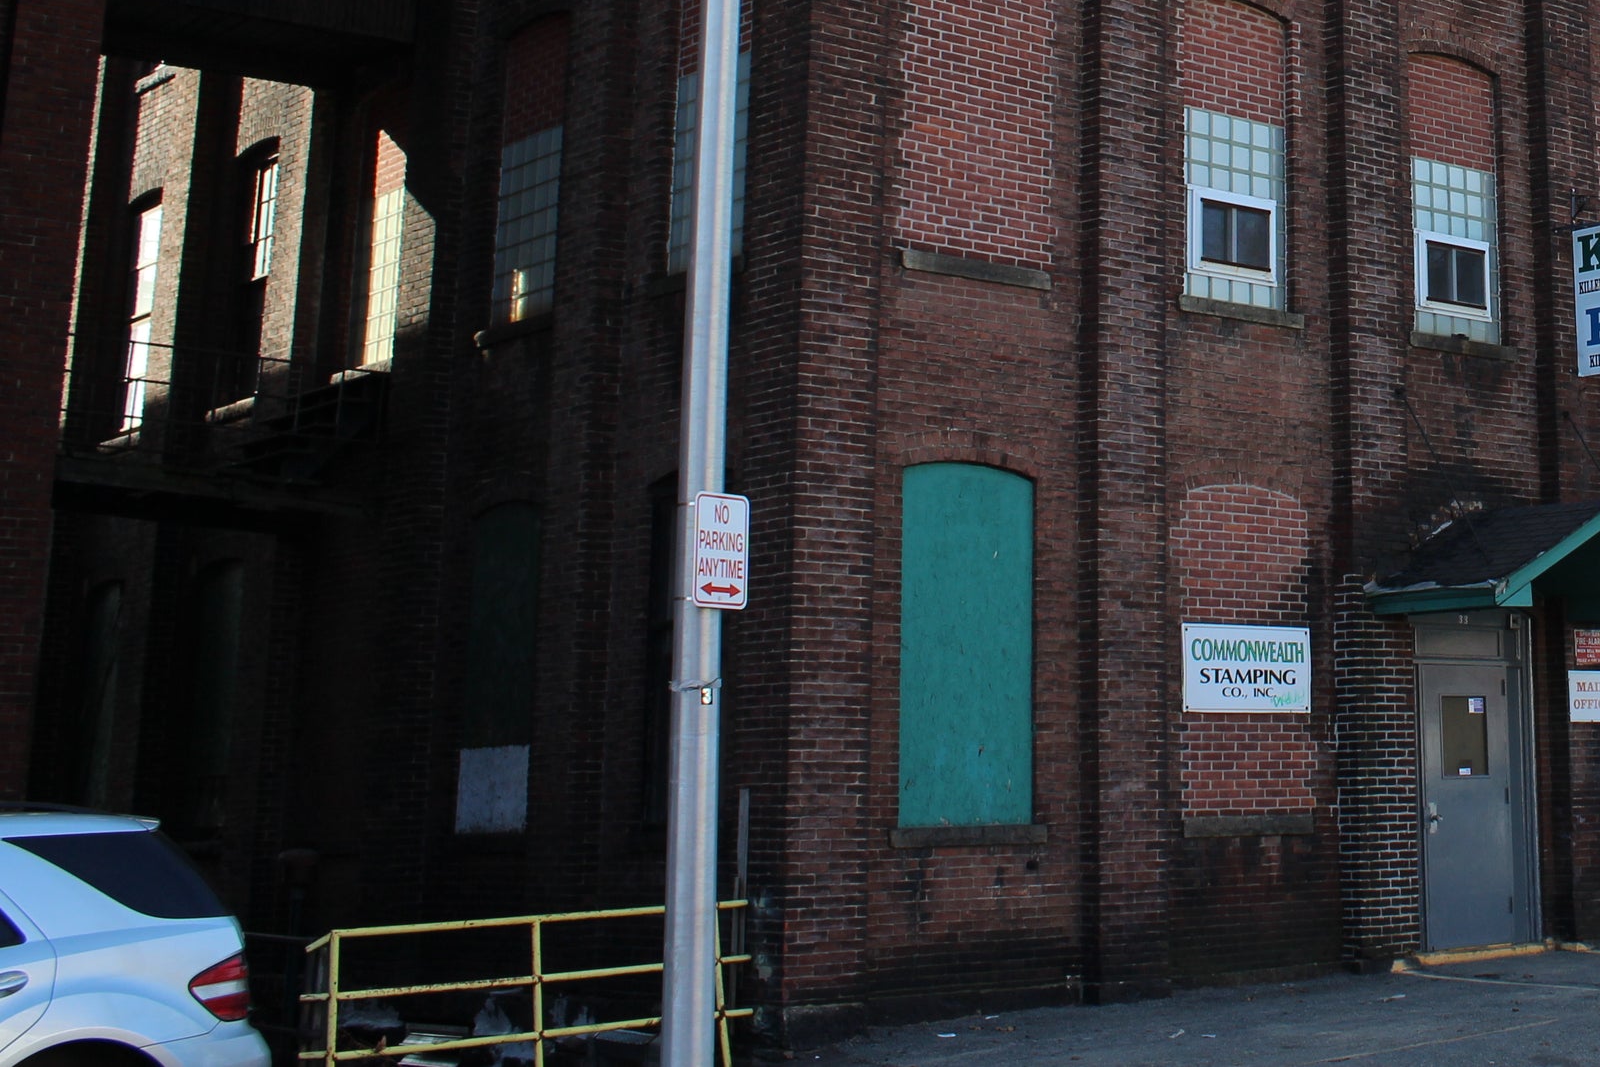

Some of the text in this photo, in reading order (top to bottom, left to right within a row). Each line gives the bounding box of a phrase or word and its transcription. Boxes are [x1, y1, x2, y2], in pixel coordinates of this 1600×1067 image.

[714, 504, 730, 524] NO
[699, 530, 743, 553] PARKING
[698, 557, 743, 579] ANYTIME
[1191, 638, 1305, 663] COMMONWEALTH
[1200, 668, 1296, 685] STAMPING
[702, 687, 712, 704] 3
[1222, 686, 1277, 699] CO., INC.
